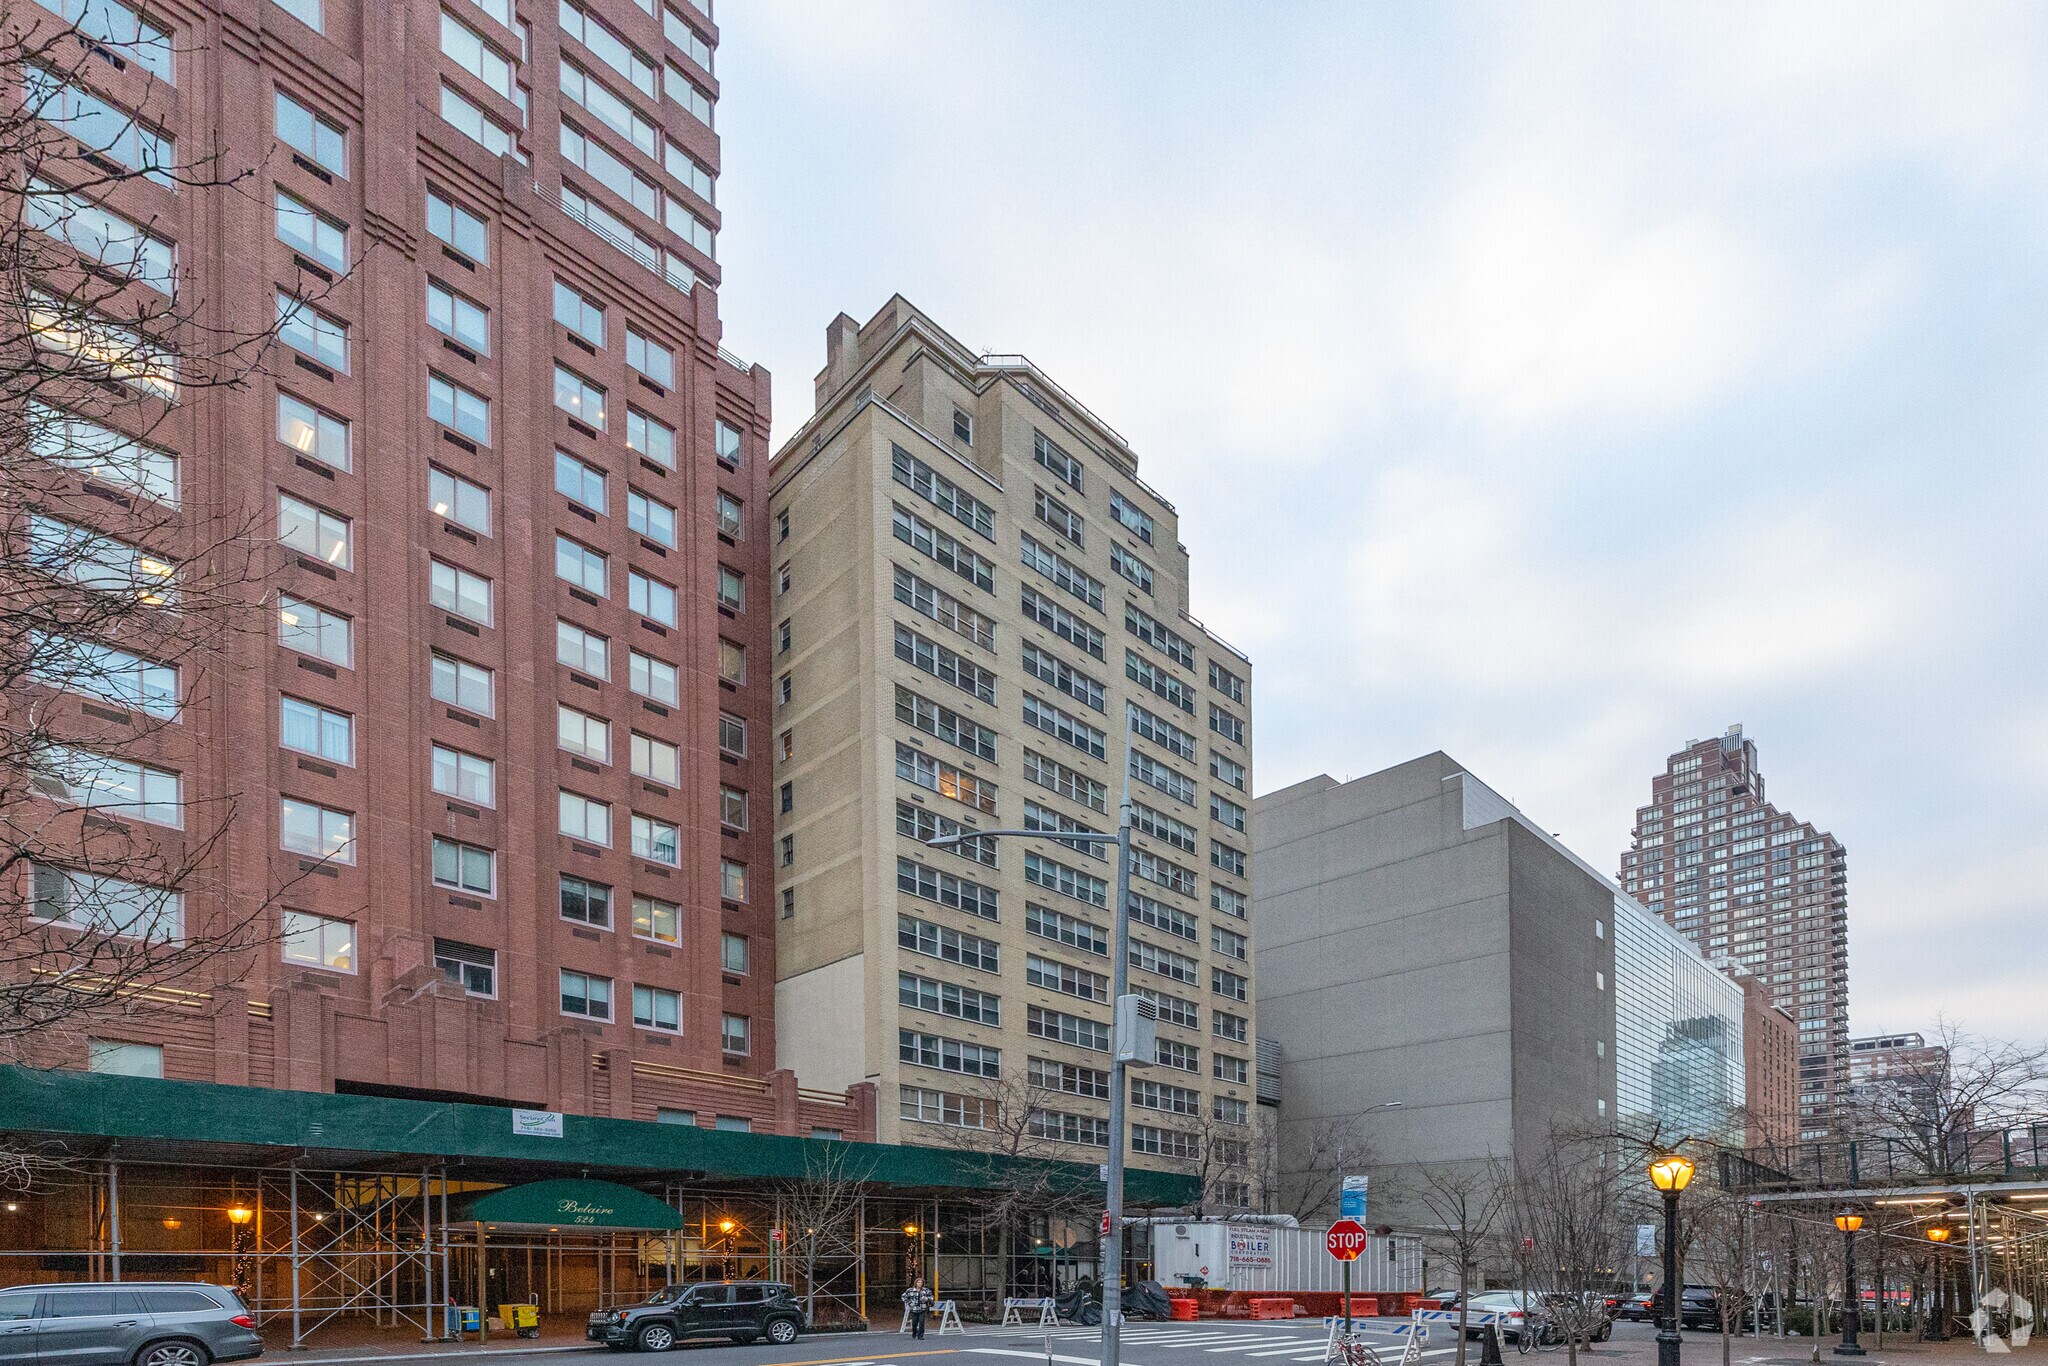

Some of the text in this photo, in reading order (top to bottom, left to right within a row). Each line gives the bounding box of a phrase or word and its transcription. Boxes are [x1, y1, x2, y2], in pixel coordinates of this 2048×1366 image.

[557, 1199, 614, 1215] Belaire
[574, 1215, 595, 1224] 524
[1231, 1240, 1269, 1251] BOILER
[1328, 1233, 1365, 1249] STOP
